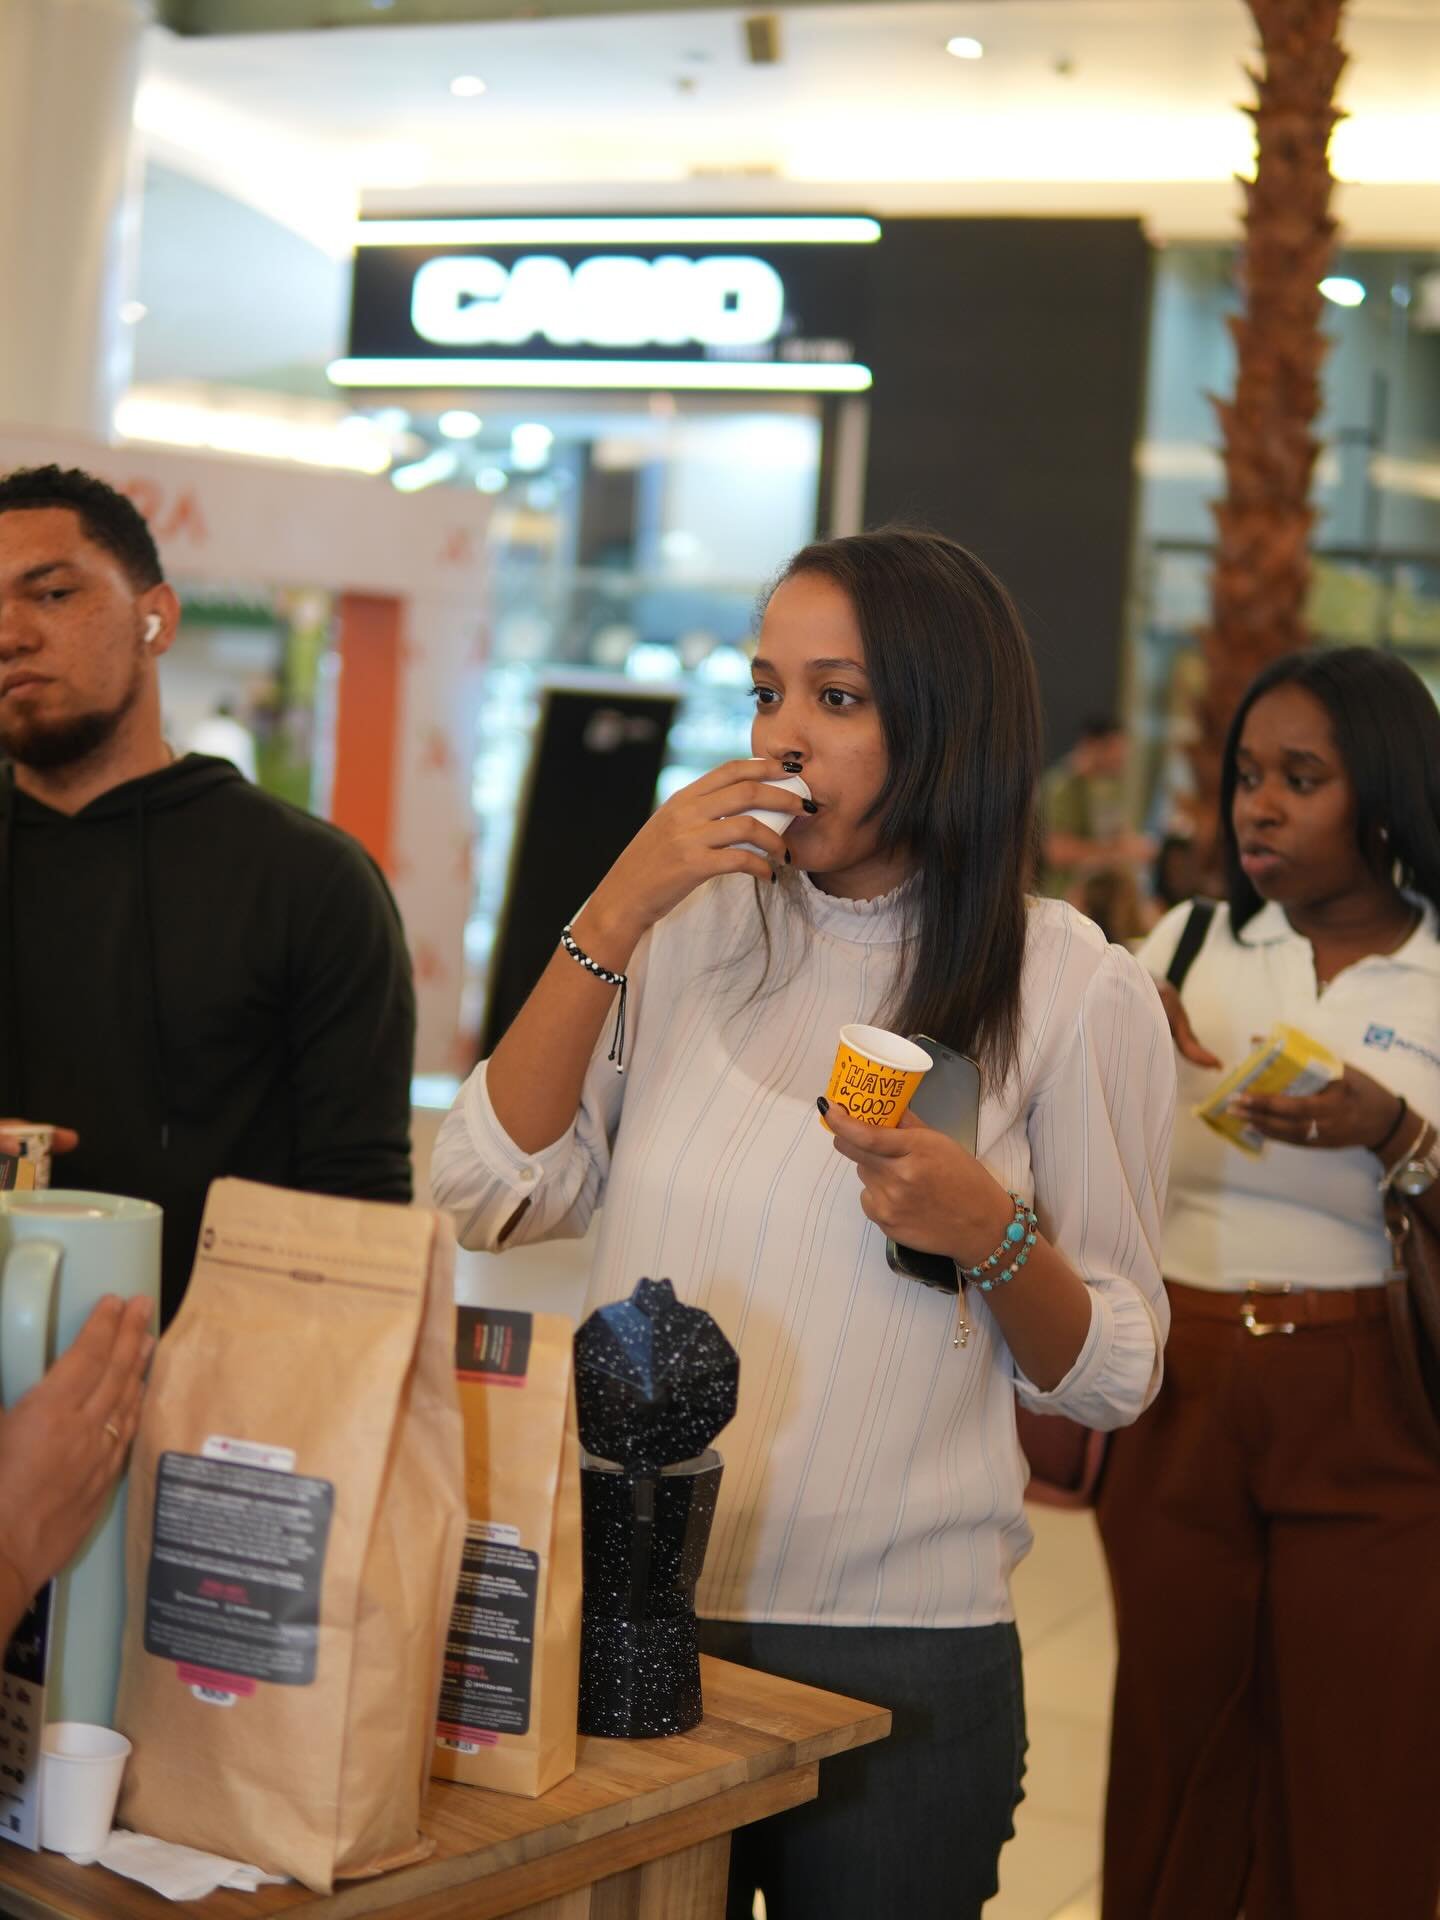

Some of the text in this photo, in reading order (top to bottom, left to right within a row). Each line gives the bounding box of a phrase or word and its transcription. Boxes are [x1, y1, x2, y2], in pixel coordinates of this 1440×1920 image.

[845, 1065, 905, 1097] HAVE
[840, 1086, 850, 1096] a
[849, 1092, 896, 1116] GOOD
